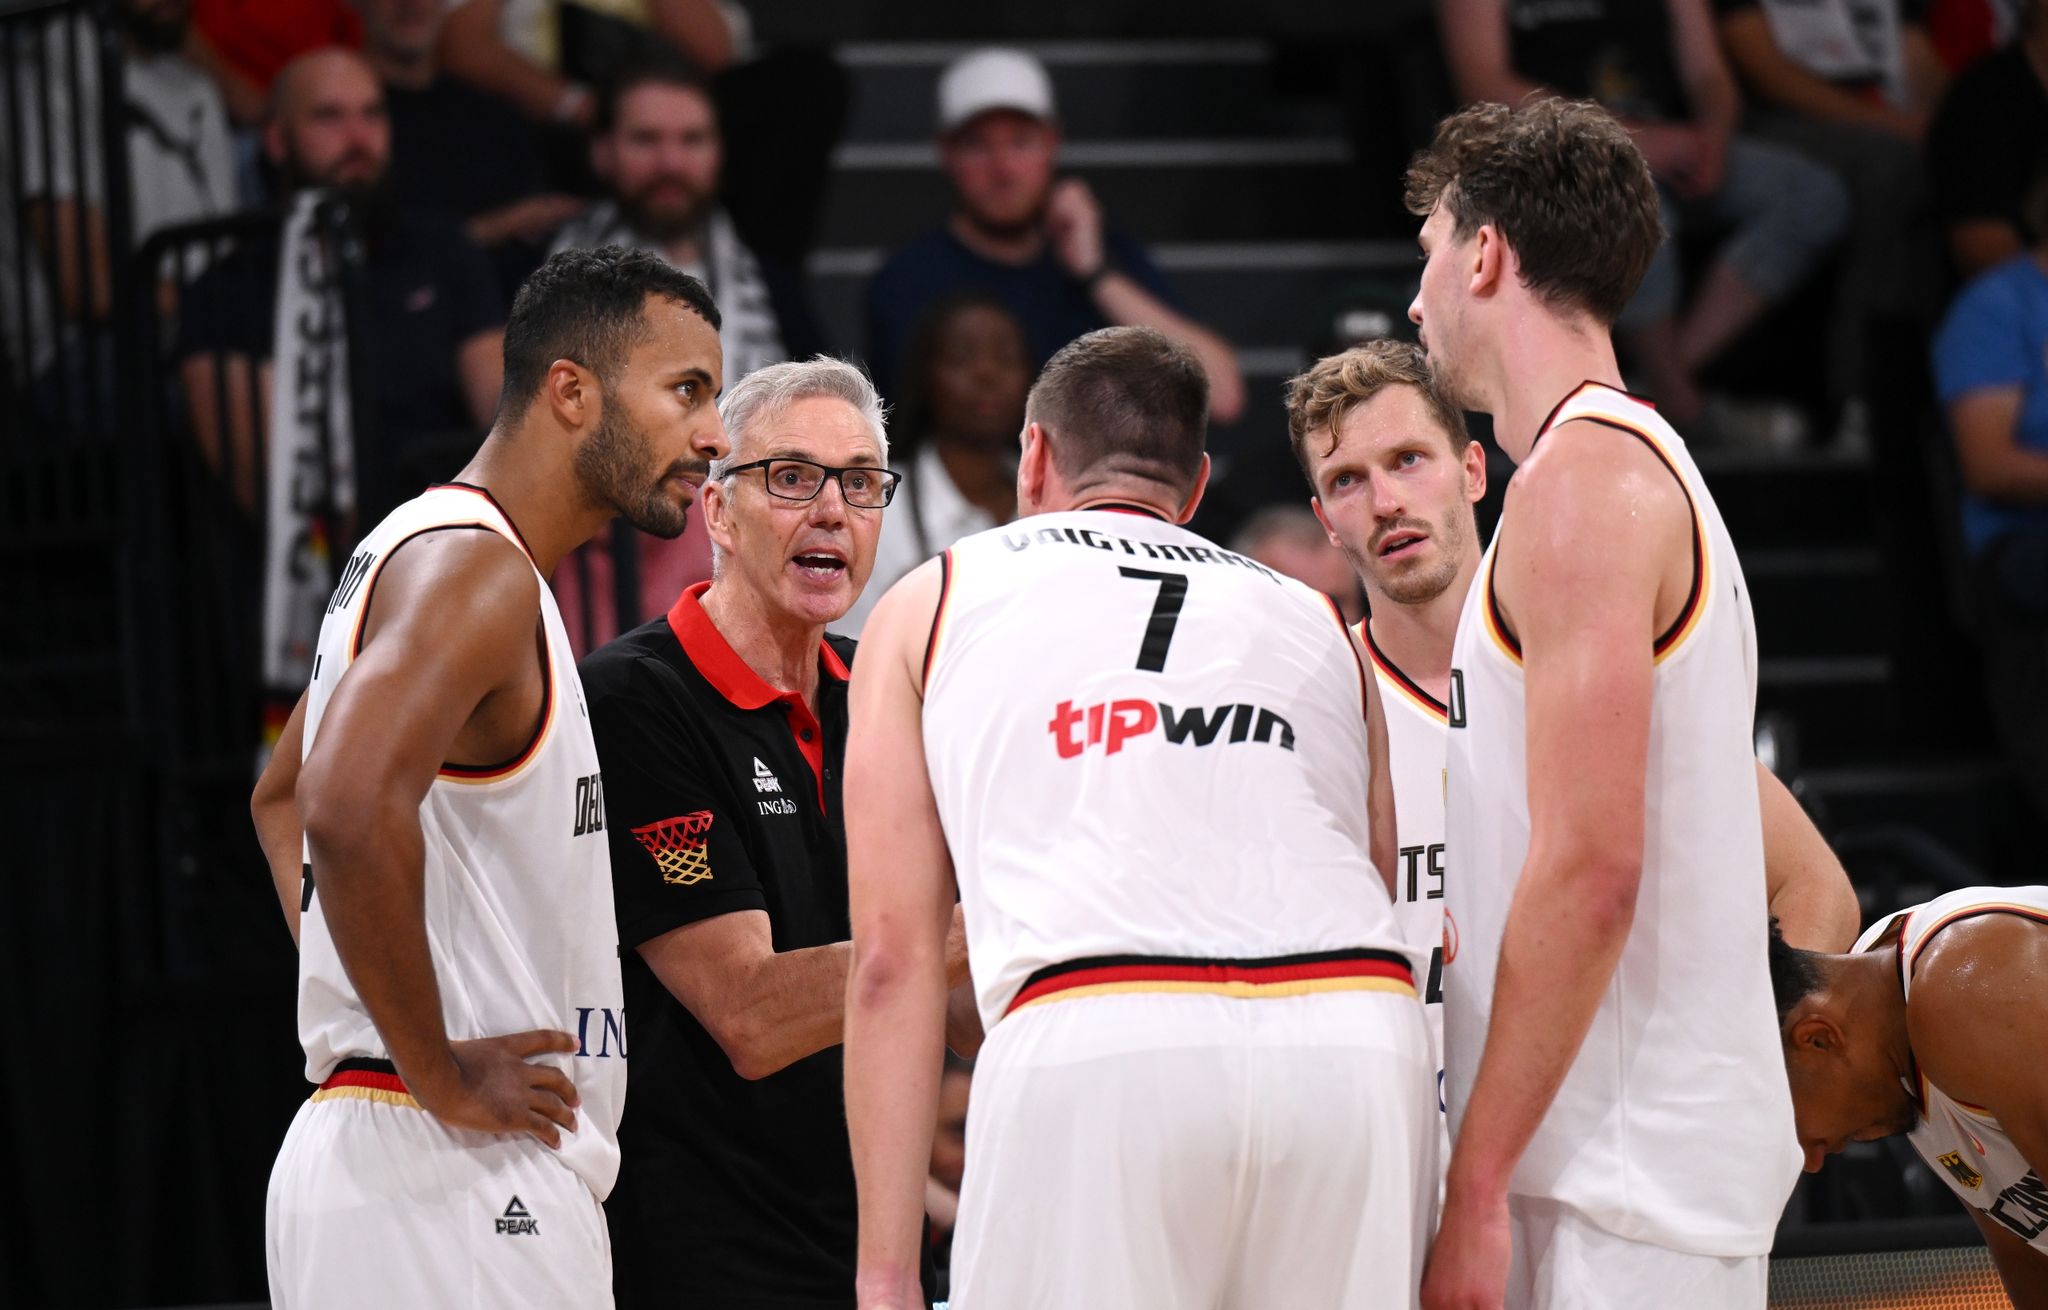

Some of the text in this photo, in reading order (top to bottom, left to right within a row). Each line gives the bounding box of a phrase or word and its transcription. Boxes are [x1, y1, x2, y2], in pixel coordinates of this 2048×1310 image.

[1117, 565, 1189, 673] 7
[1048, 698, 1295, 760] tipwin
[752, 777, 783, 793] PEAK
[757, 800, 782, 815] ING
[1400, 843, 1446, 902] TS
[495, 1218, 541, 1236] PEAK
